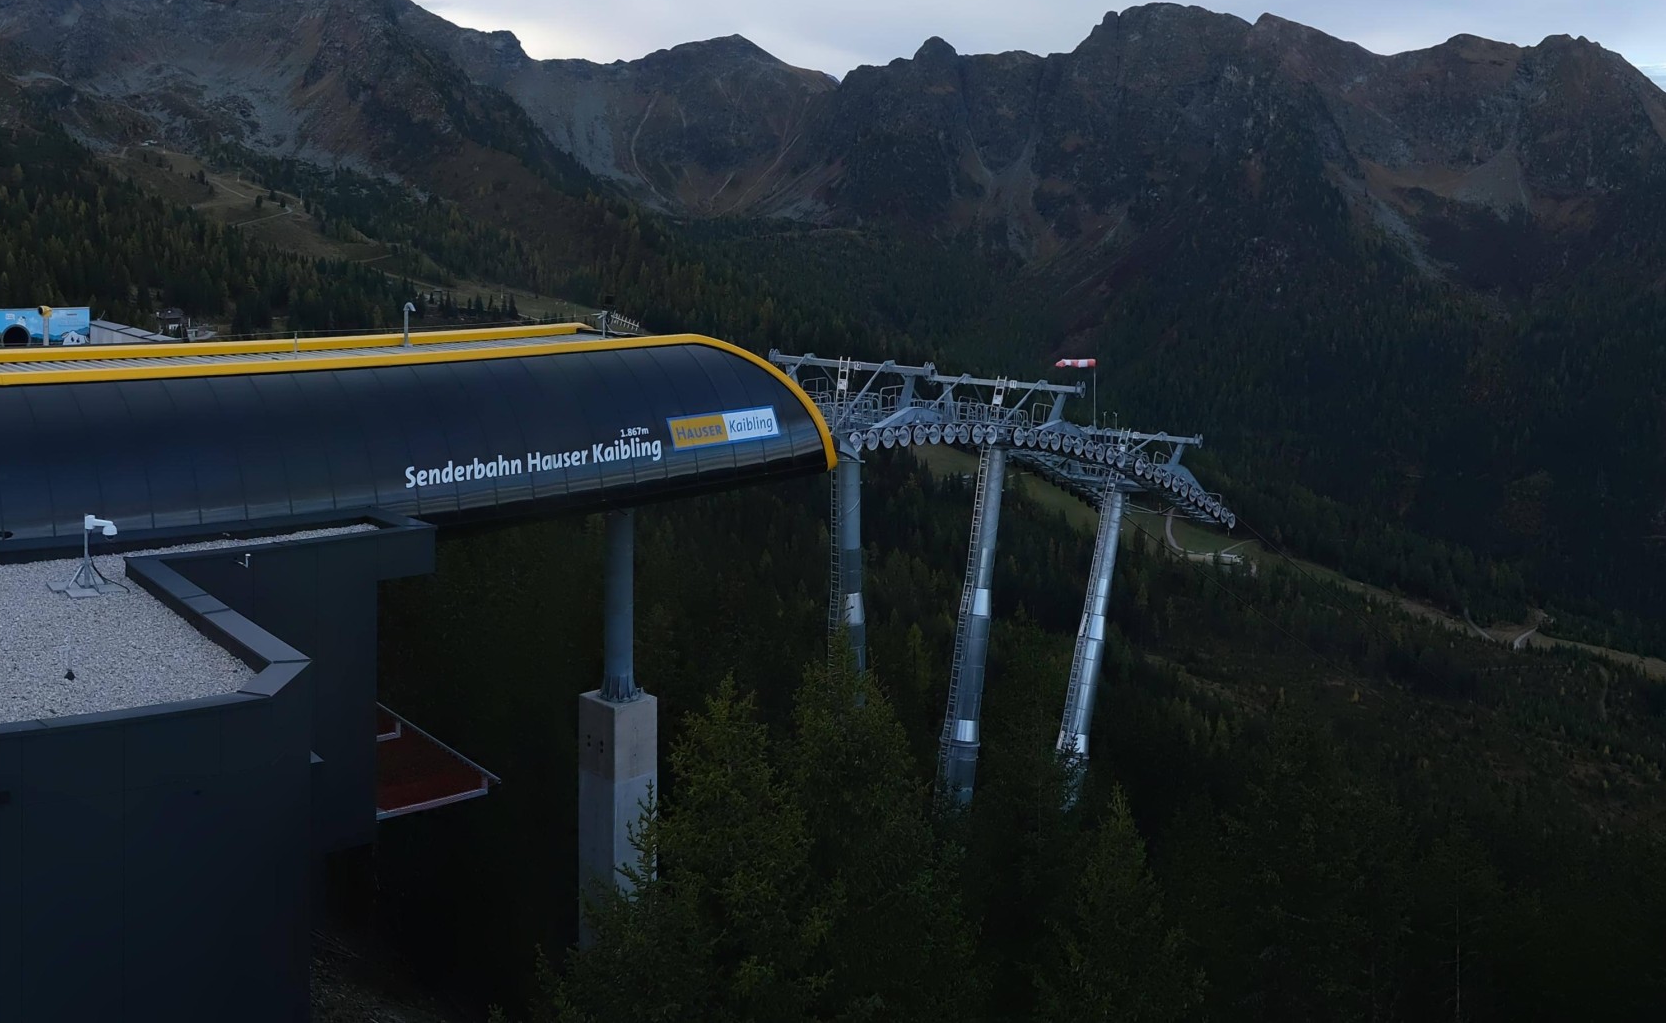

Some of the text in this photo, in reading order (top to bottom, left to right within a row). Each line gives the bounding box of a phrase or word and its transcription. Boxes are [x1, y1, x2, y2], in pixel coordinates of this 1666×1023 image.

[620, 426, 650, 438] 1.867m
[676, 416, 774, 440] HAUSER Kaibling
[404, 438, 662, 488] Senderbahn Hauser Kaibling
